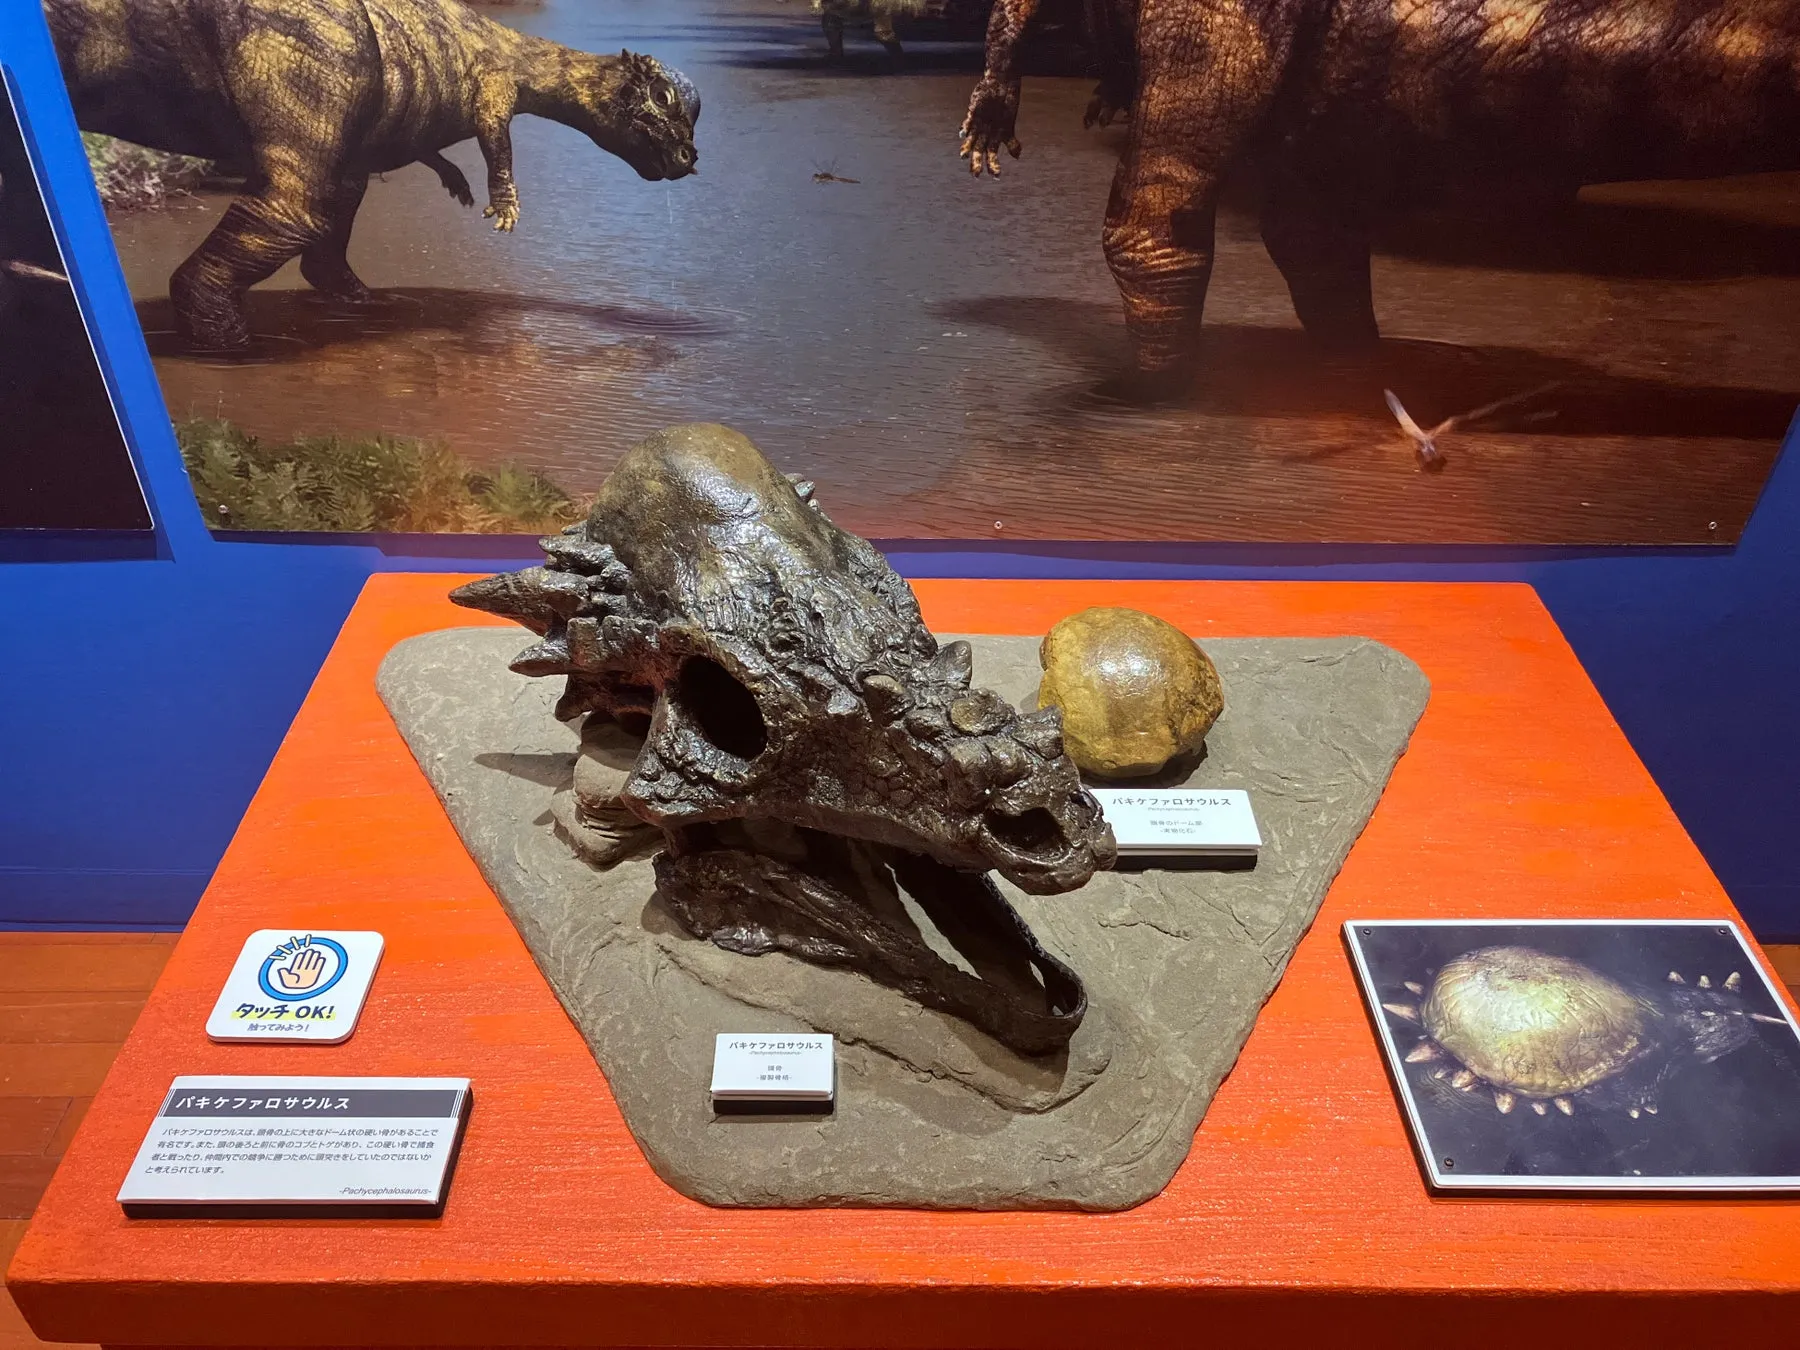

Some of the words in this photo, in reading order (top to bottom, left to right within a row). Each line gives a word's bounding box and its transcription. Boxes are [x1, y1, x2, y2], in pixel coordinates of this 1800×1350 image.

[1113, 798, 1232, 806] パキケファロサウルス
[236, 1003, 290, 1019] タッチ
[295, 1006, 335, 1019] OK!
[730, 1041, 823, 1050] パキケファロサウルス
[176, 1097, 350, 1110] パキケファロサウルス
[145, 1166, 224, 1174] と考えられています。
[339, 1187, 432, 1196] -Pachycephalosaurus-
